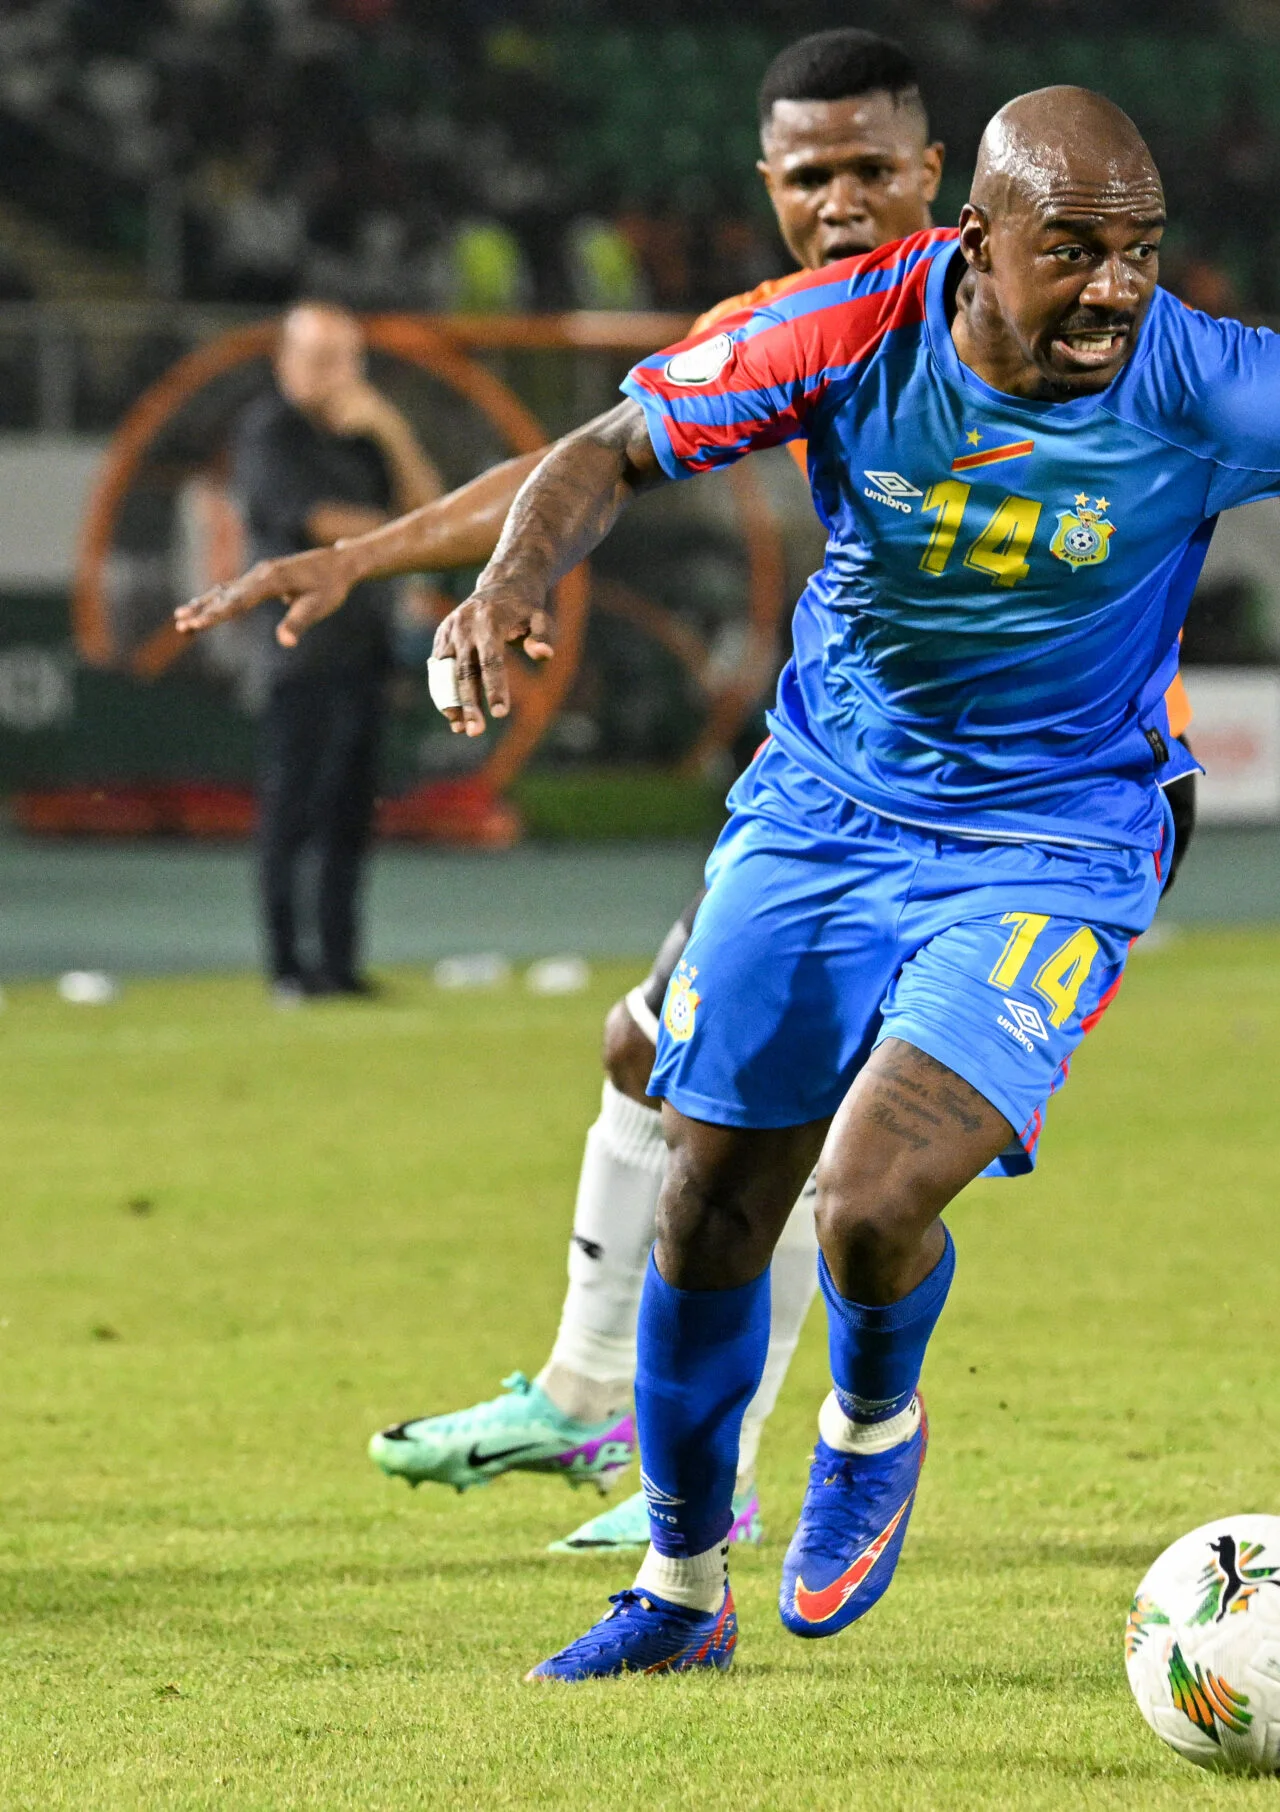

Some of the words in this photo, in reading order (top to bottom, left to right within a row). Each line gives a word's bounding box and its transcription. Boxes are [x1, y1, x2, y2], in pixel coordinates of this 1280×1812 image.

[864, 487, 912, 514] umbro
[918, 479, 1043, 588] 14
[987, 911, 1100, 1030] 14
[996, 1015, 1035, 1053] umbro
[647, 1502, 678, 1525] bro
